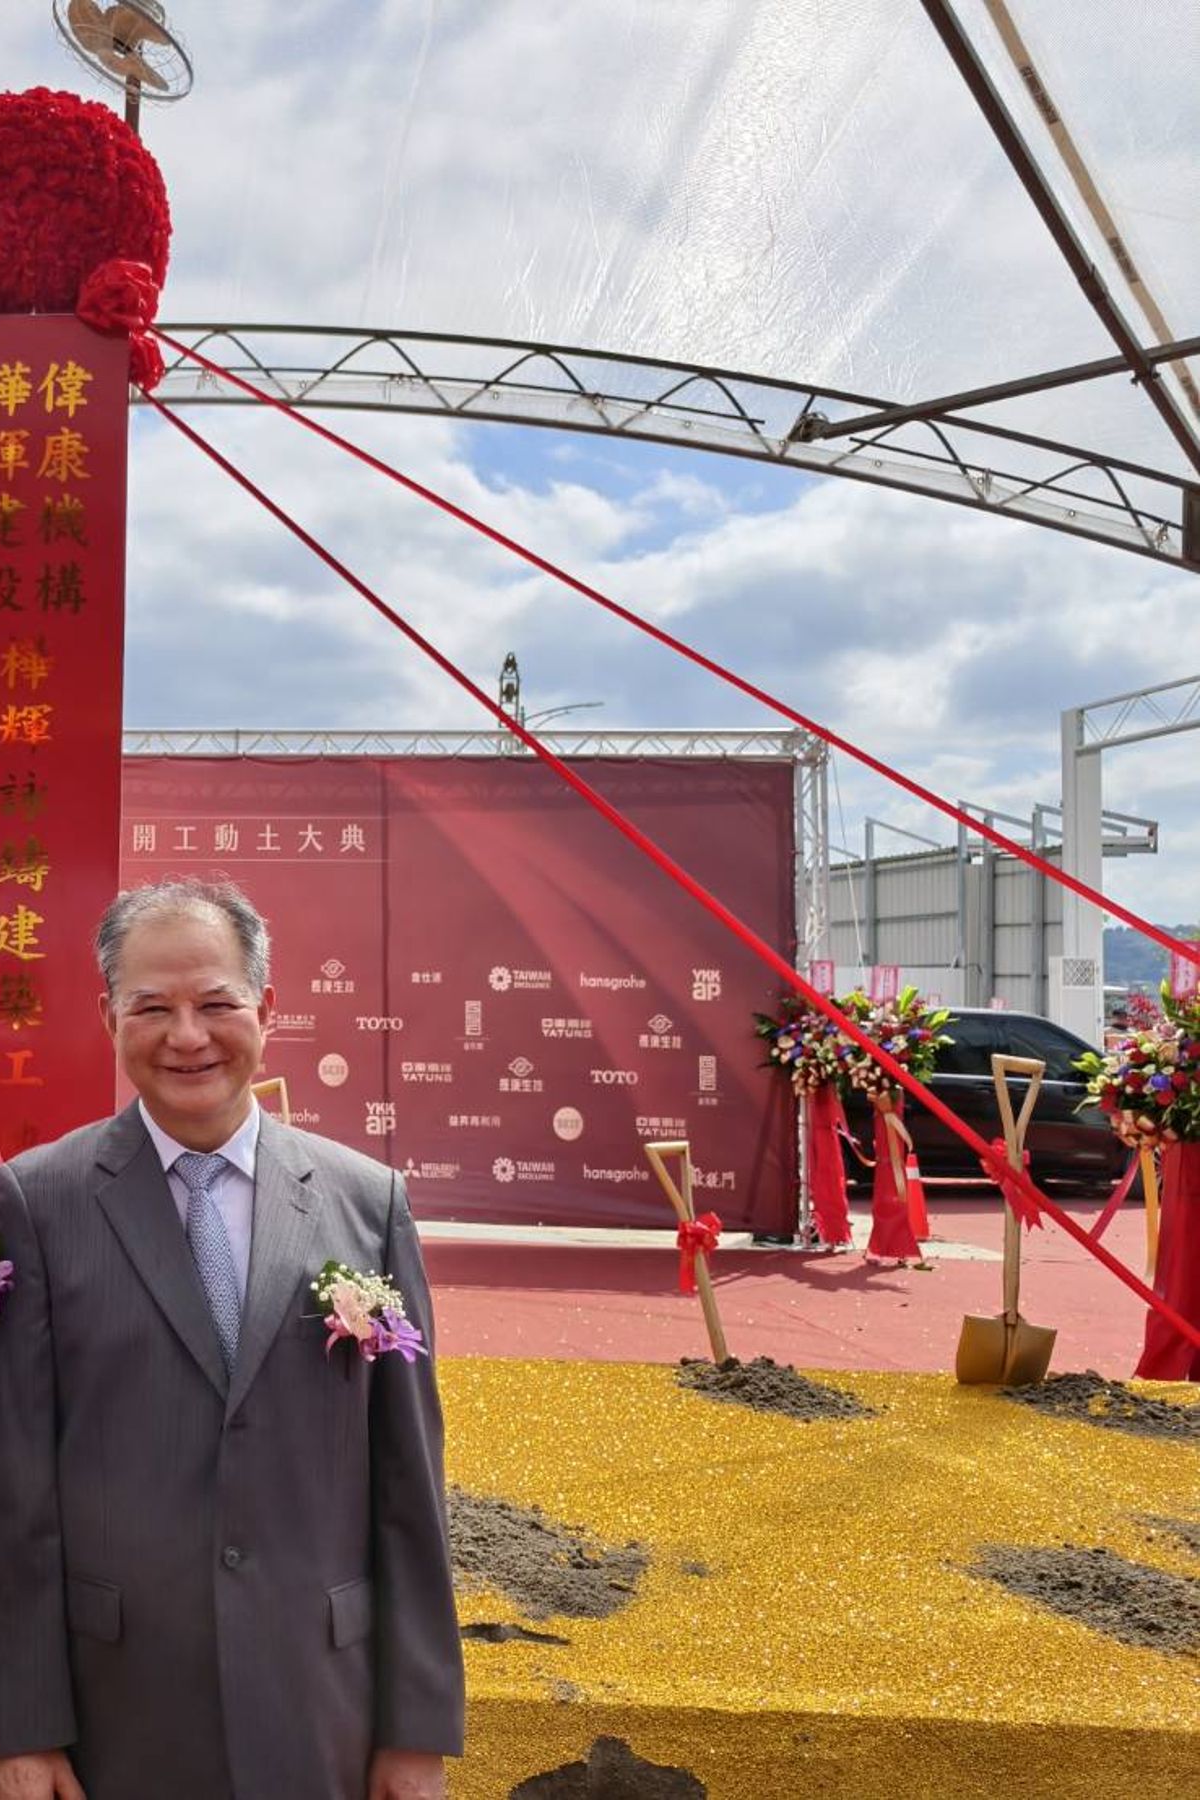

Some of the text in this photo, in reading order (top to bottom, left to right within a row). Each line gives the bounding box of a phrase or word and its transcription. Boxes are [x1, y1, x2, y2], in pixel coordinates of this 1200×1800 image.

[38, 360, 94, 614] 偉康機構
[132, 823, 366, 854] 開工動土大典
[514, 970, 551, 981] TAIWAN
[580, 972, 646, 990] hansgrohe
[692, 969, 721, 982] YKK
[692, 983, 721, 1001] ap
[357, 1017, 403, 1030] TOTO
[402, 1073, 452, 1083] YATUNG
[590, 1070, 638, 1085] TOTO
[366, 1102, 395, 1115] YKK
[366, 1116, 395, 1135] ap
[584, 1164, 648, 1183] hansgrohe
